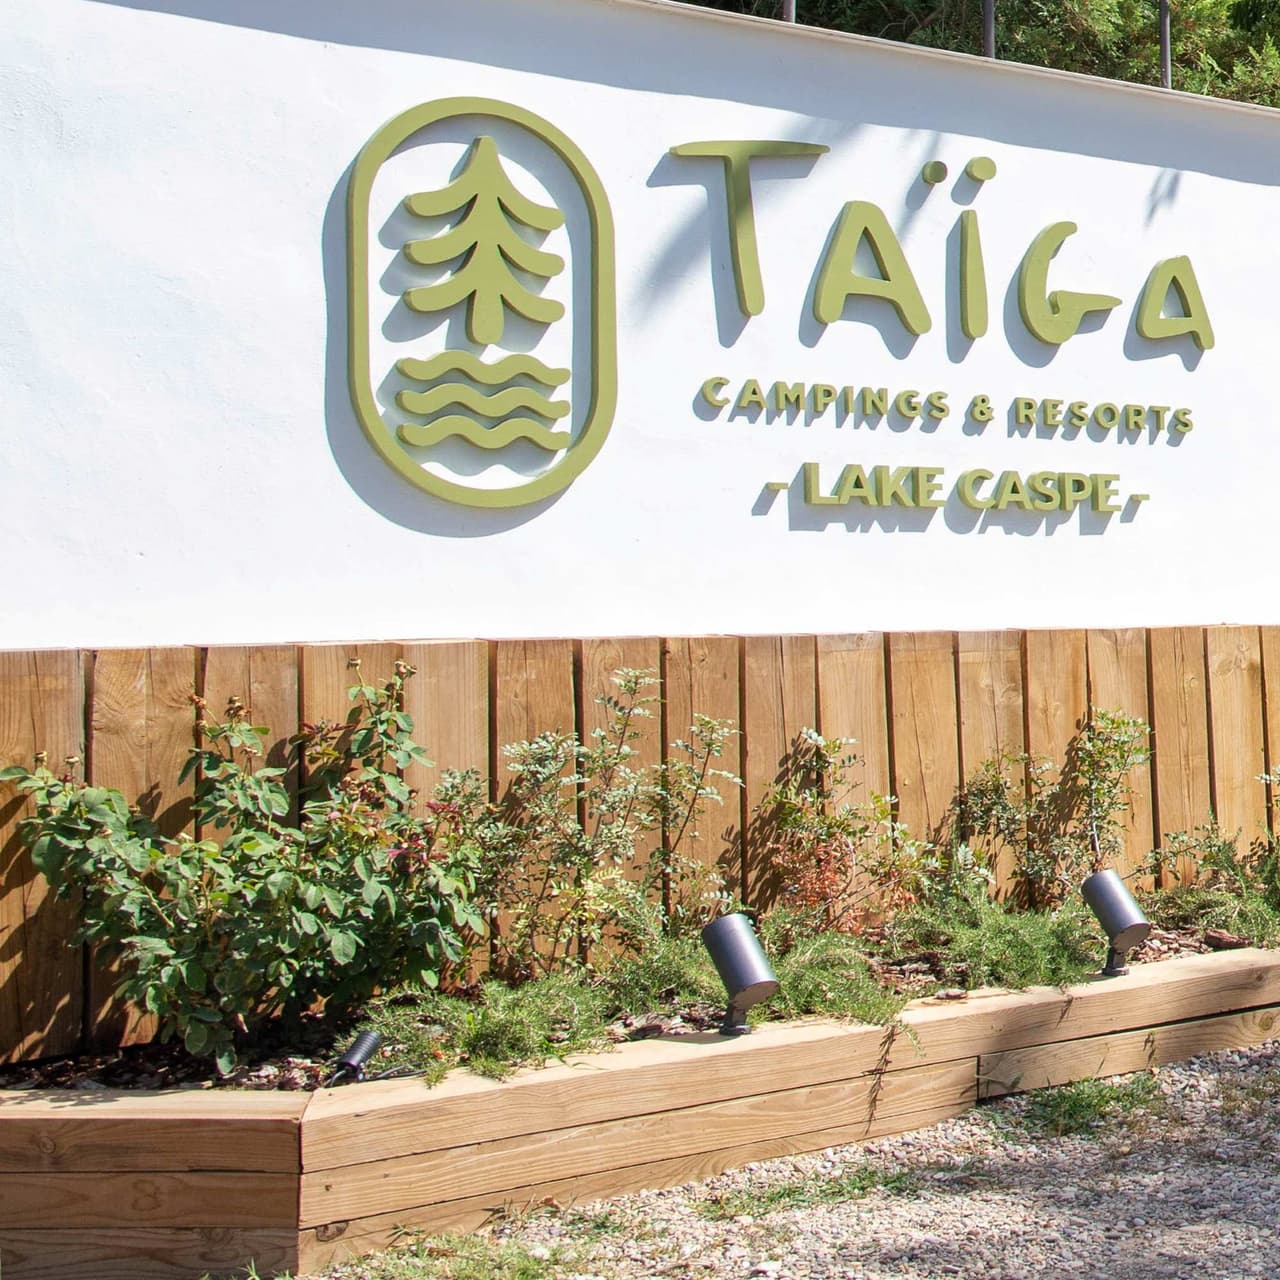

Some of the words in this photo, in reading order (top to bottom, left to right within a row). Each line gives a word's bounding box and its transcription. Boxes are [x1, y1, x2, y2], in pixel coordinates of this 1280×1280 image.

[701, 376, 949, 420] CAMPINGS
[970, 394, 994, 422] &
[1016, 396, 1193, 433] RESORTS
